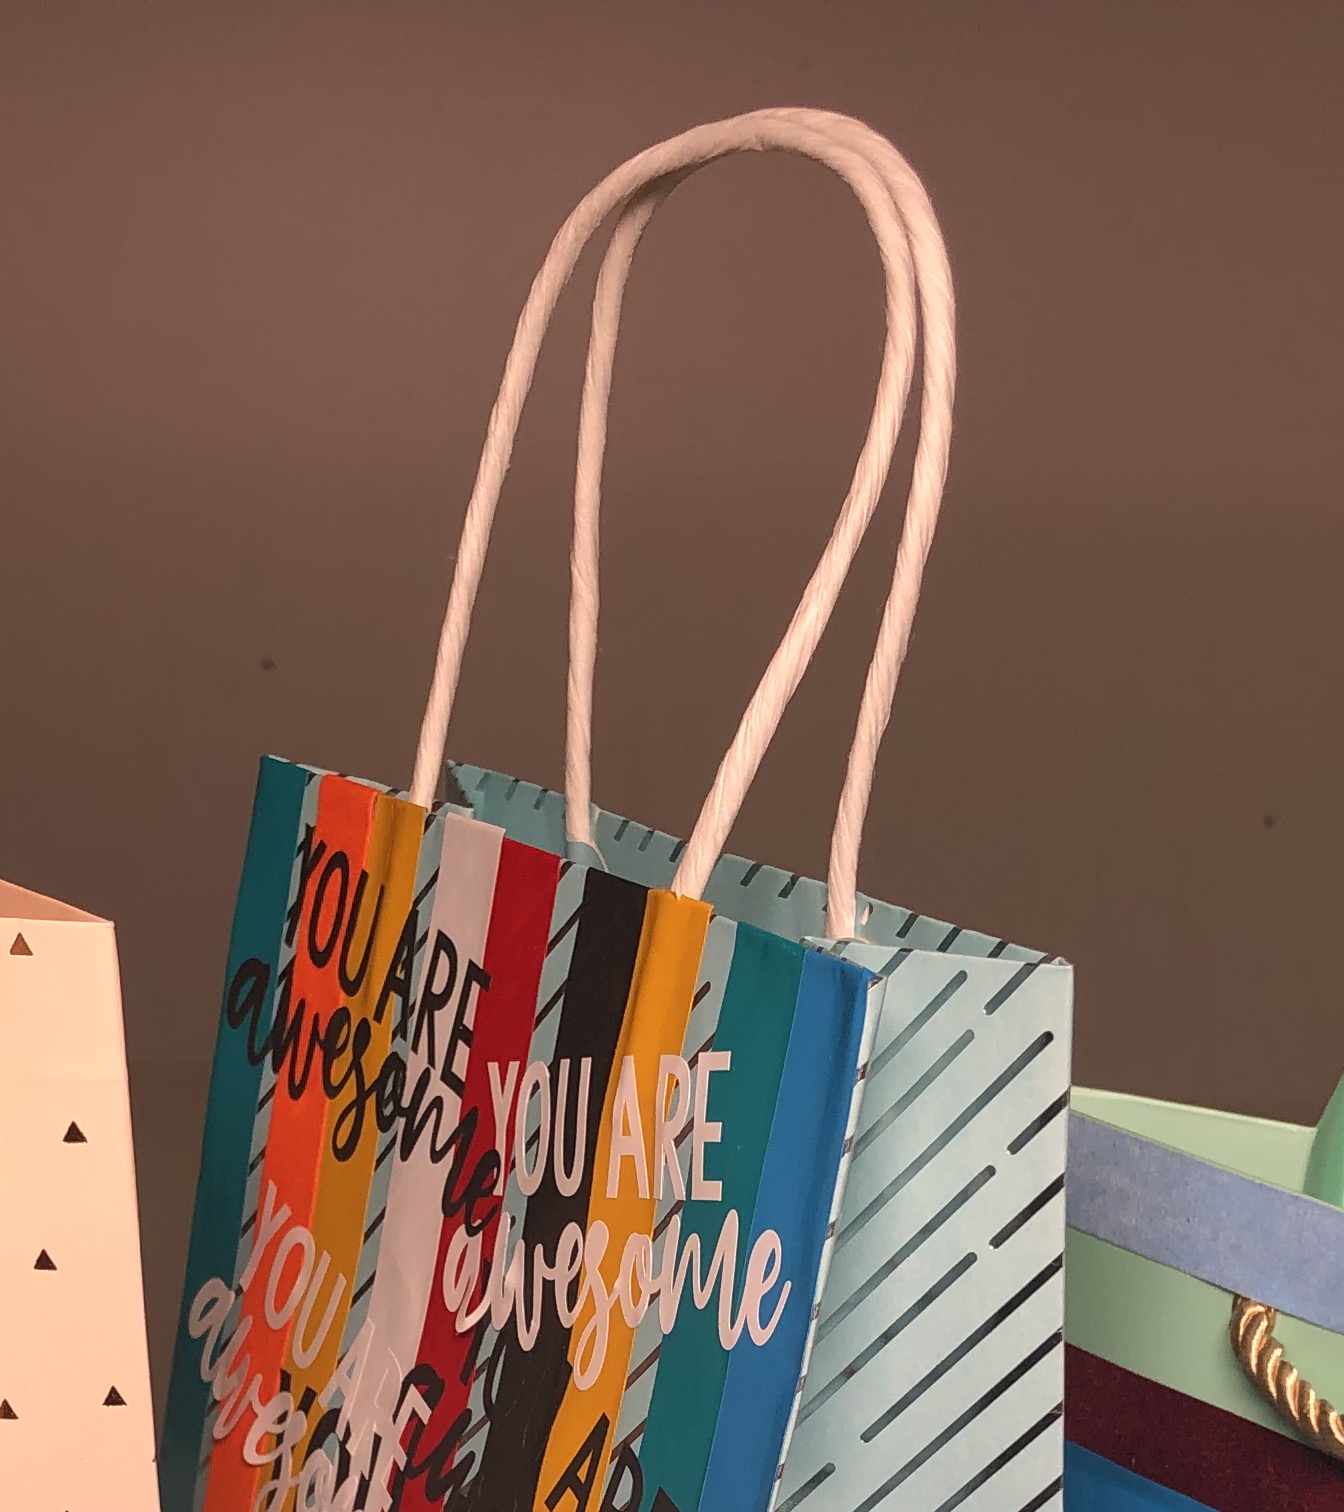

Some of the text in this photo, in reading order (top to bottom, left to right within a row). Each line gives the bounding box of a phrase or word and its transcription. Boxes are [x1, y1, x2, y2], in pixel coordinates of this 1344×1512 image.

[288, 824, 491, 1098] YOU ARE
[227, 957, 507, 1236] awesome
[487, 1051, 733, 1202] YOU ARE
[239, 1178, 348, 1370] YOU
[442, 1208, 792, 1390] awesome
